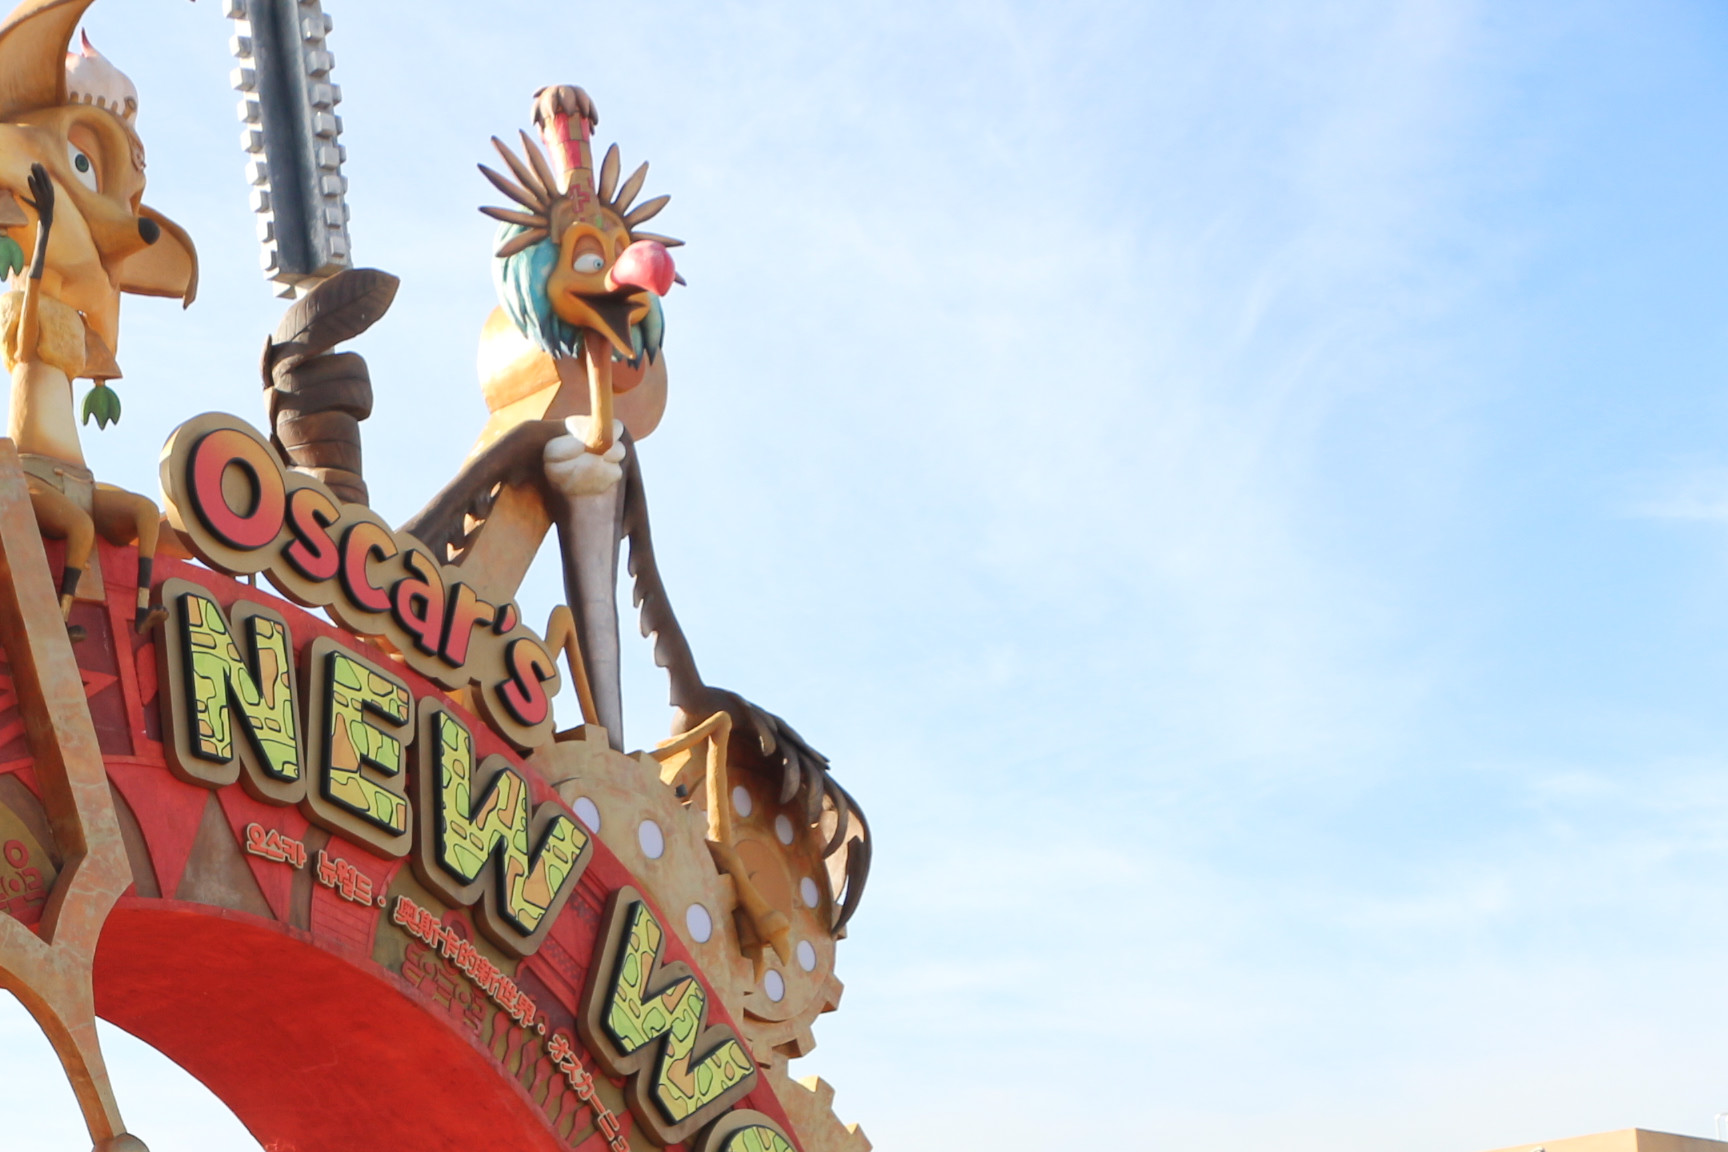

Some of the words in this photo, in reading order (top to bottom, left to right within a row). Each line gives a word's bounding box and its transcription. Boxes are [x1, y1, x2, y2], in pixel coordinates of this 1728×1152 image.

[186, 427, 556, 728] Oscar's
[178, 592, 589, 937] NEW
[247, 823, 307, 869] 오스카
[318, 850, 373, 906] 뉴월드
